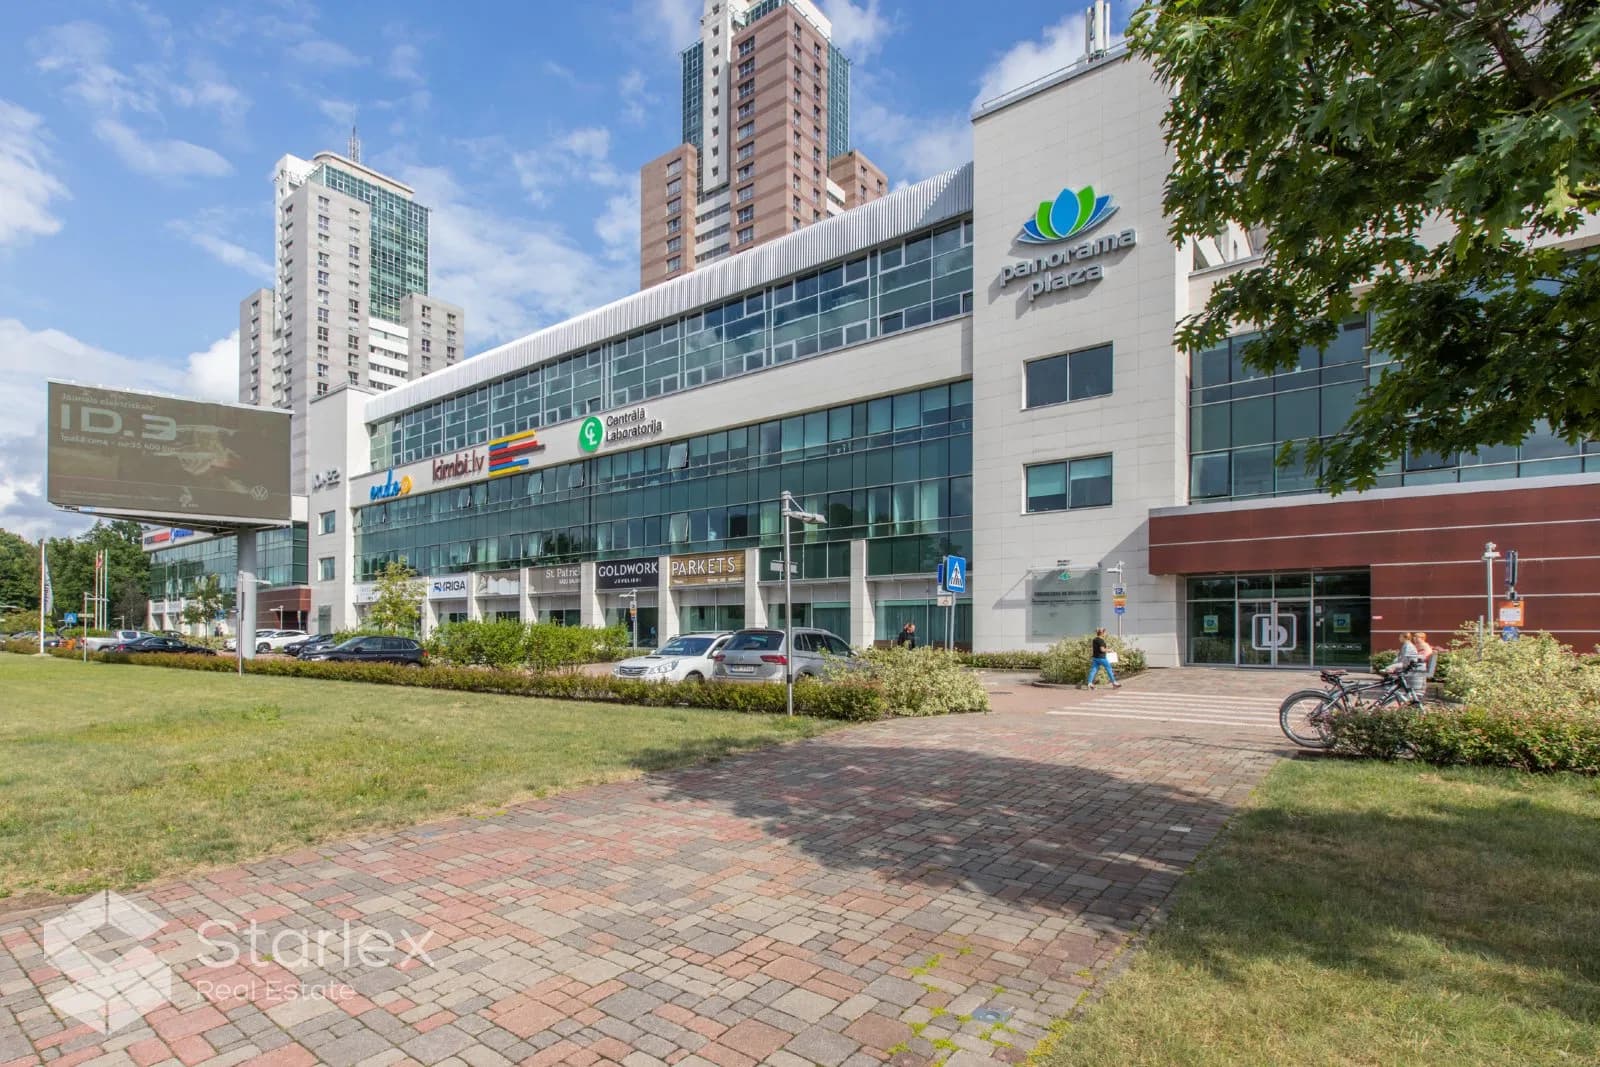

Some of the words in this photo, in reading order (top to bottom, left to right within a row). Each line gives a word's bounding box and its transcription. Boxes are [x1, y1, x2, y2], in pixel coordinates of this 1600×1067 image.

[1001, 227, 1137, 287] panorama
[1028, 263, 1104, 303] plaza
[61, 403, 177, 441] ID.3
[606, 419, 664, 442] Laboratorija
[432, 449, 485, 481] kimbi.lv
[598, 561, 659, 577] GOLDWORK
[671, 556, 736, 576] PARKETS
